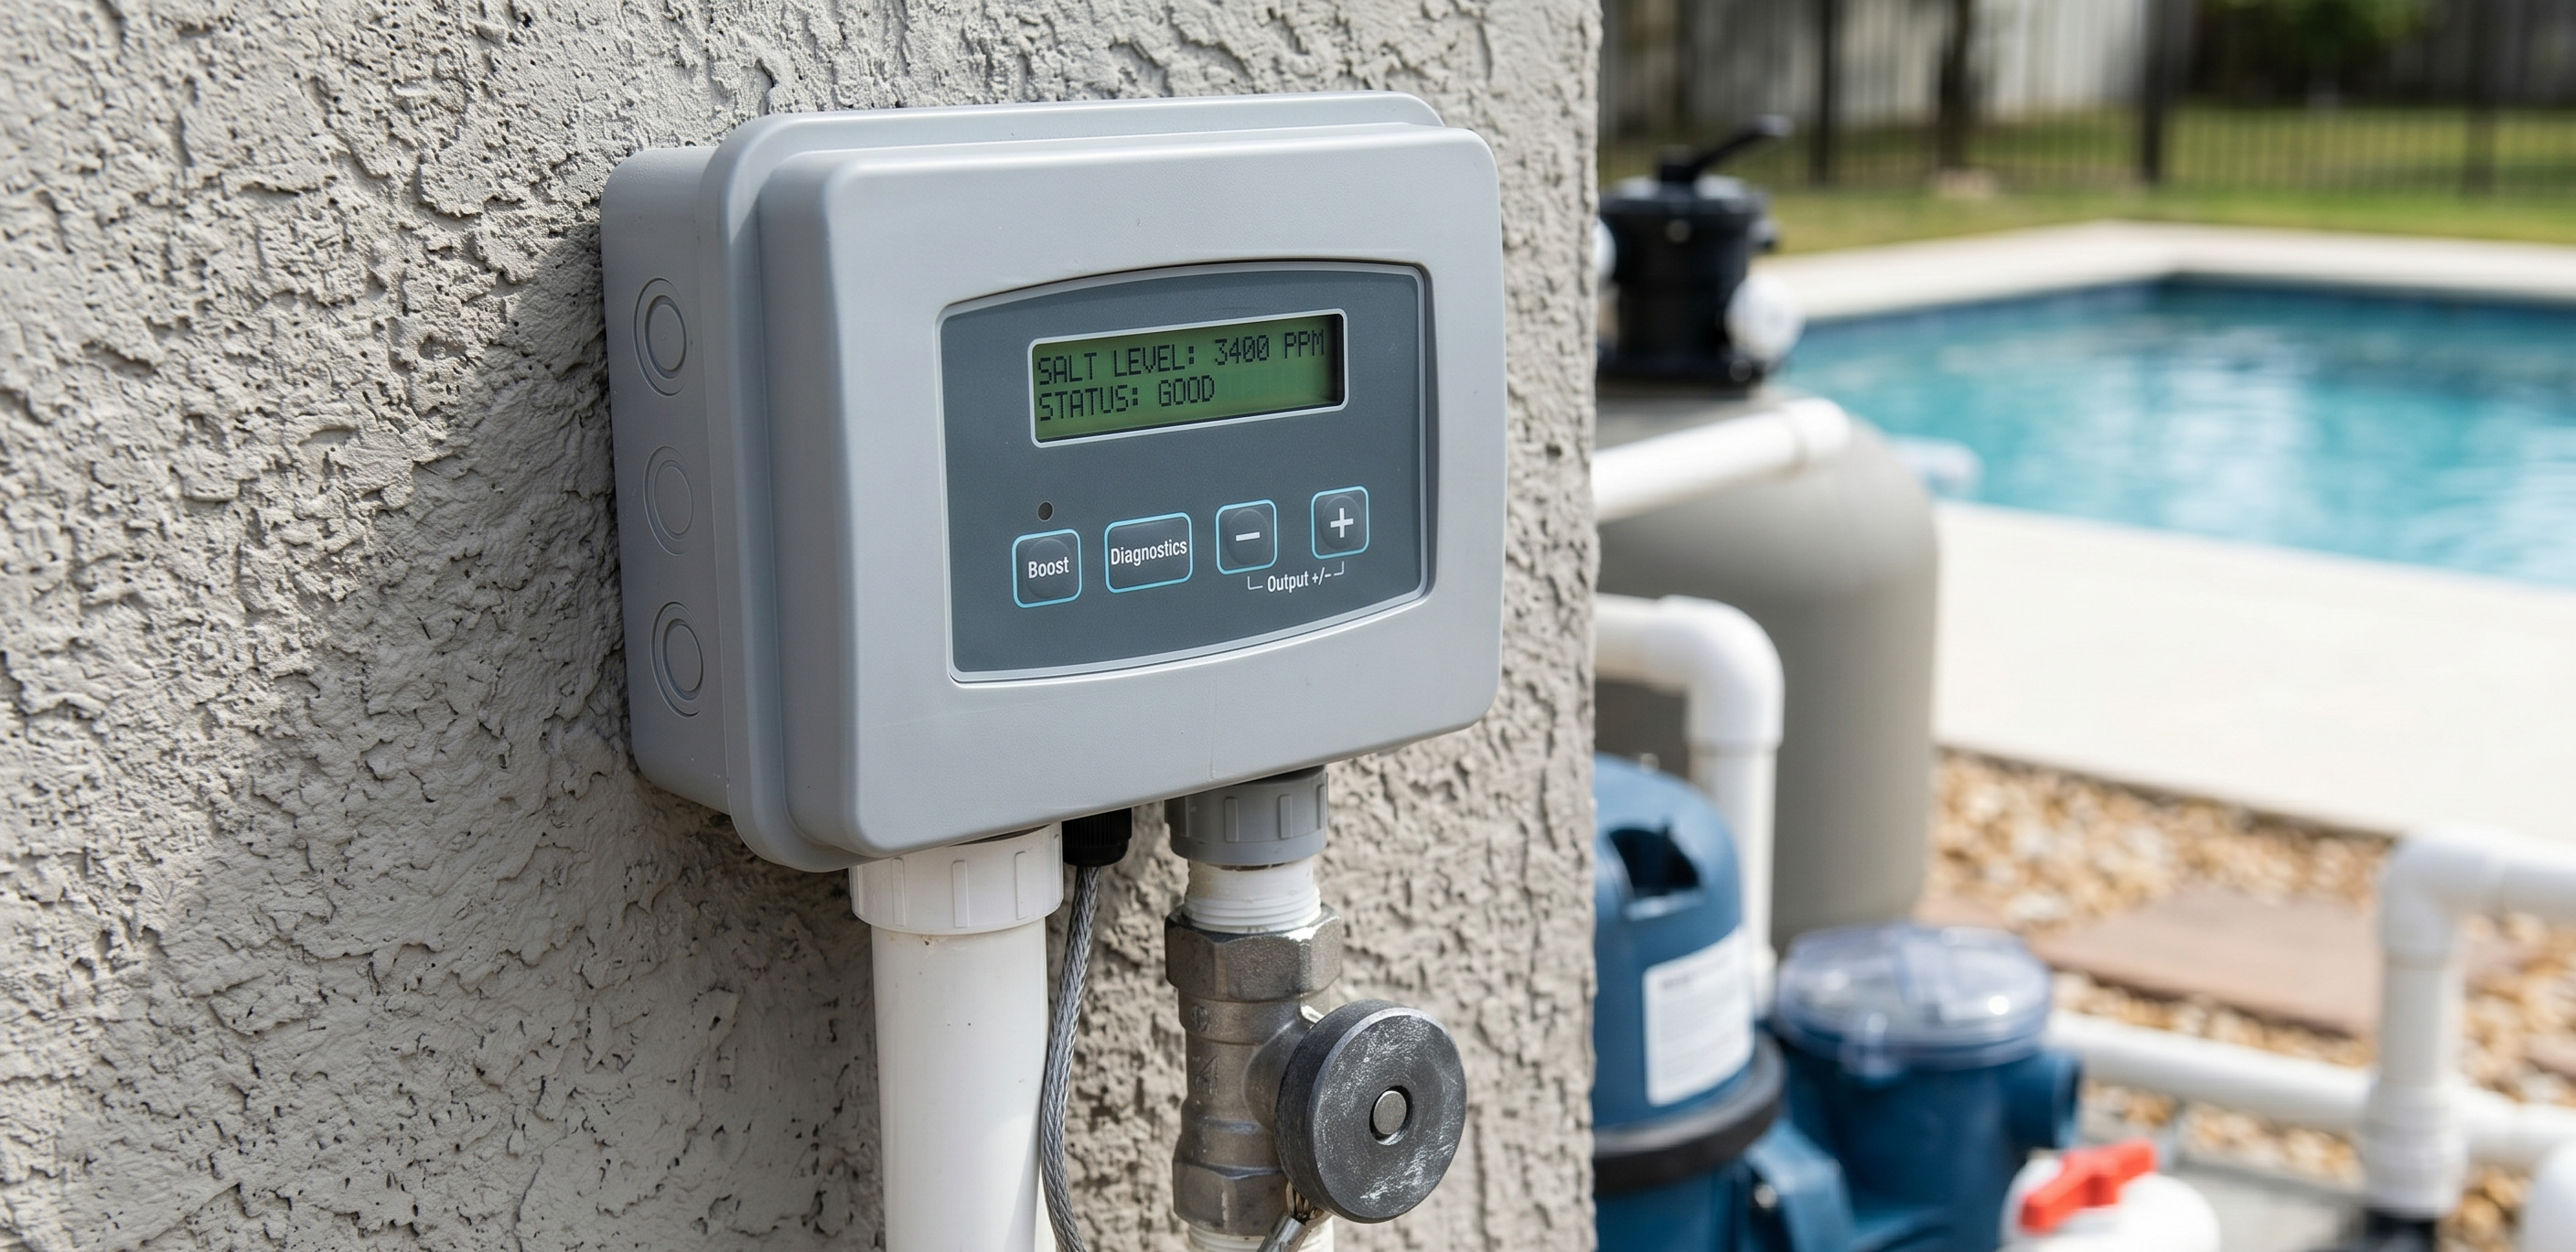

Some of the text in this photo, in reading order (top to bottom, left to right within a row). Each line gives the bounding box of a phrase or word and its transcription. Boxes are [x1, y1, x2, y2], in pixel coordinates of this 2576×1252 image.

[1038, 329, 1325, 385] SALT LEVEL: 3400 PPM
[1039, 375, 1215, 421] STATUS: GOOD
[1111, 539, 1187, 567] Diagnostics
[1028, 557, 1070, 579] Boost
[1267, 571, 1309, 594] Output
